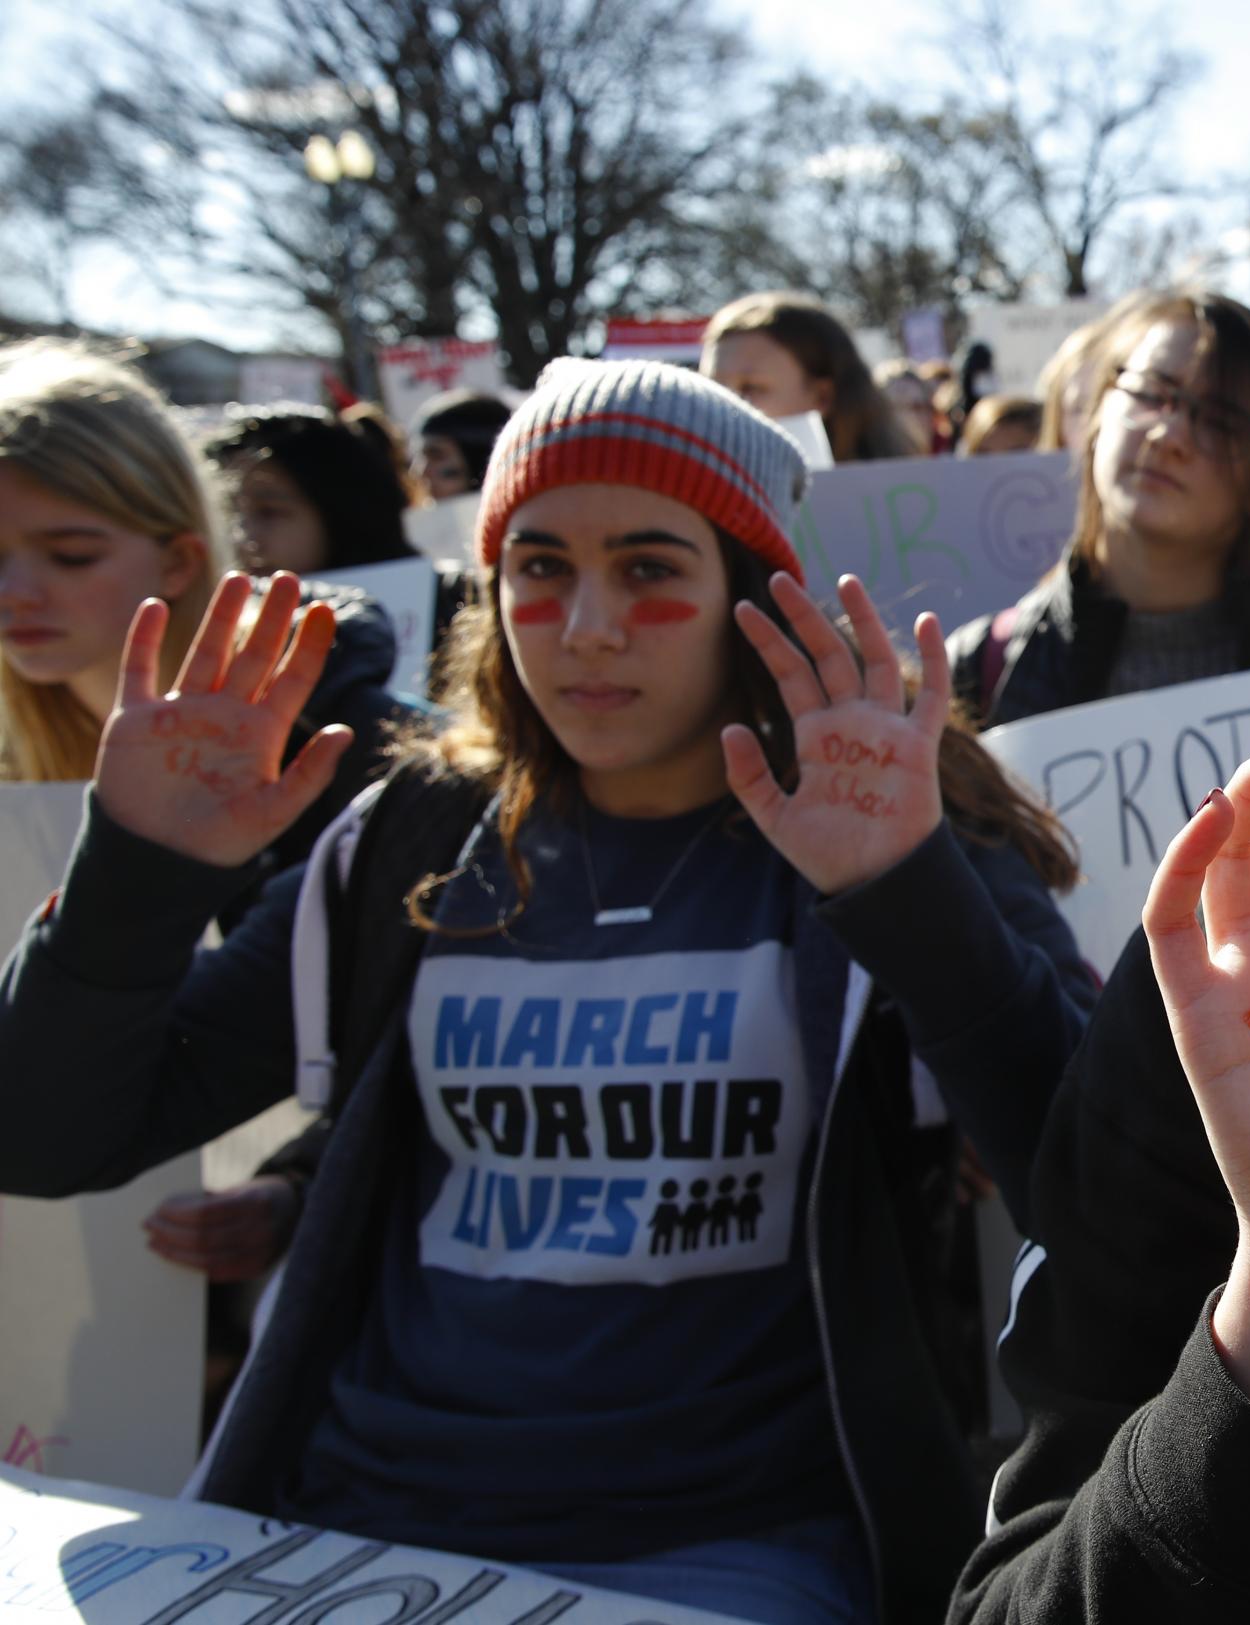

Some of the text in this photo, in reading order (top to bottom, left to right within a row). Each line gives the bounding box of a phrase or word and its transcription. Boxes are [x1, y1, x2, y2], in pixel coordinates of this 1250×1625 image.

[434, 991, 739, 1070] MARCH
[438, 1078, 784, 1161] FOR OUR
[451, 1165, 648, 1258] LIVES
